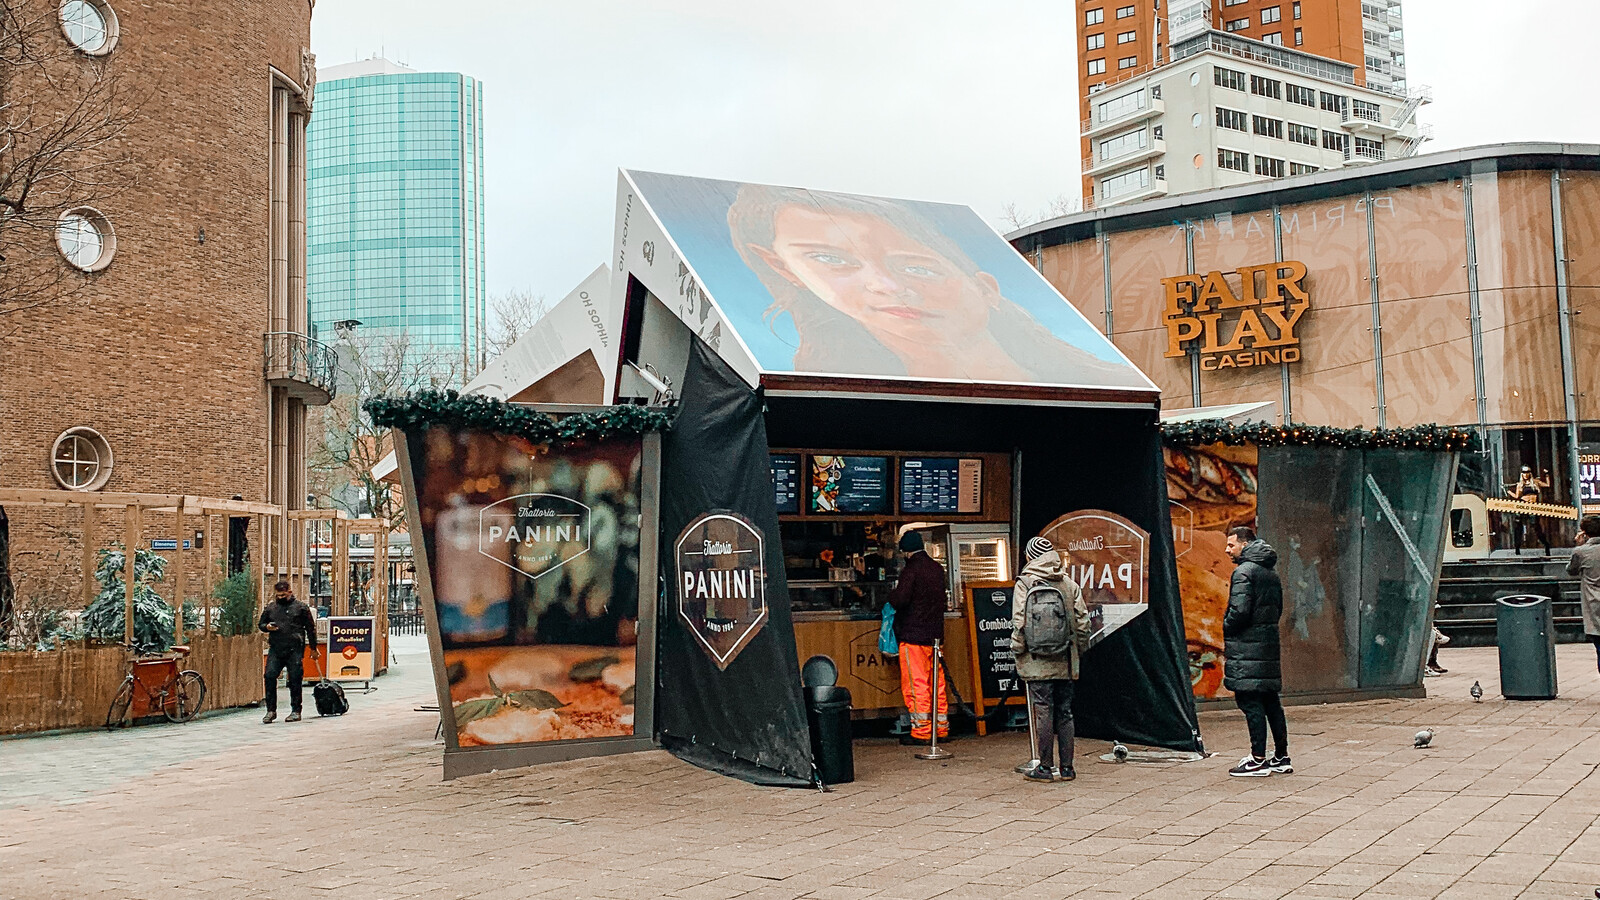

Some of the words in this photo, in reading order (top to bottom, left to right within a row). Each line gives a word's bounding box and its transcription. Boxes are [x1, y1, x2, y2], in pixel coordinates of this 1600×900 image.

[1160, 260, 1310, 316] FAIR
[579, 290, 593, 308] OH
[1162, 300, 1310, 358] PLAY
[1200, 347, 1300, 371] CASINO
[518, 506, 556, 518] Trattoria
[489, 525, 580, 543] PANINI
[703, 539, 733, 556] Trattoria
[684, 569, 756, 599] PANINI
[332, 626, 370, 635] Donner
[707, 620, 721, 632] ANNO
[979, 618, 1015, 631] Combide
